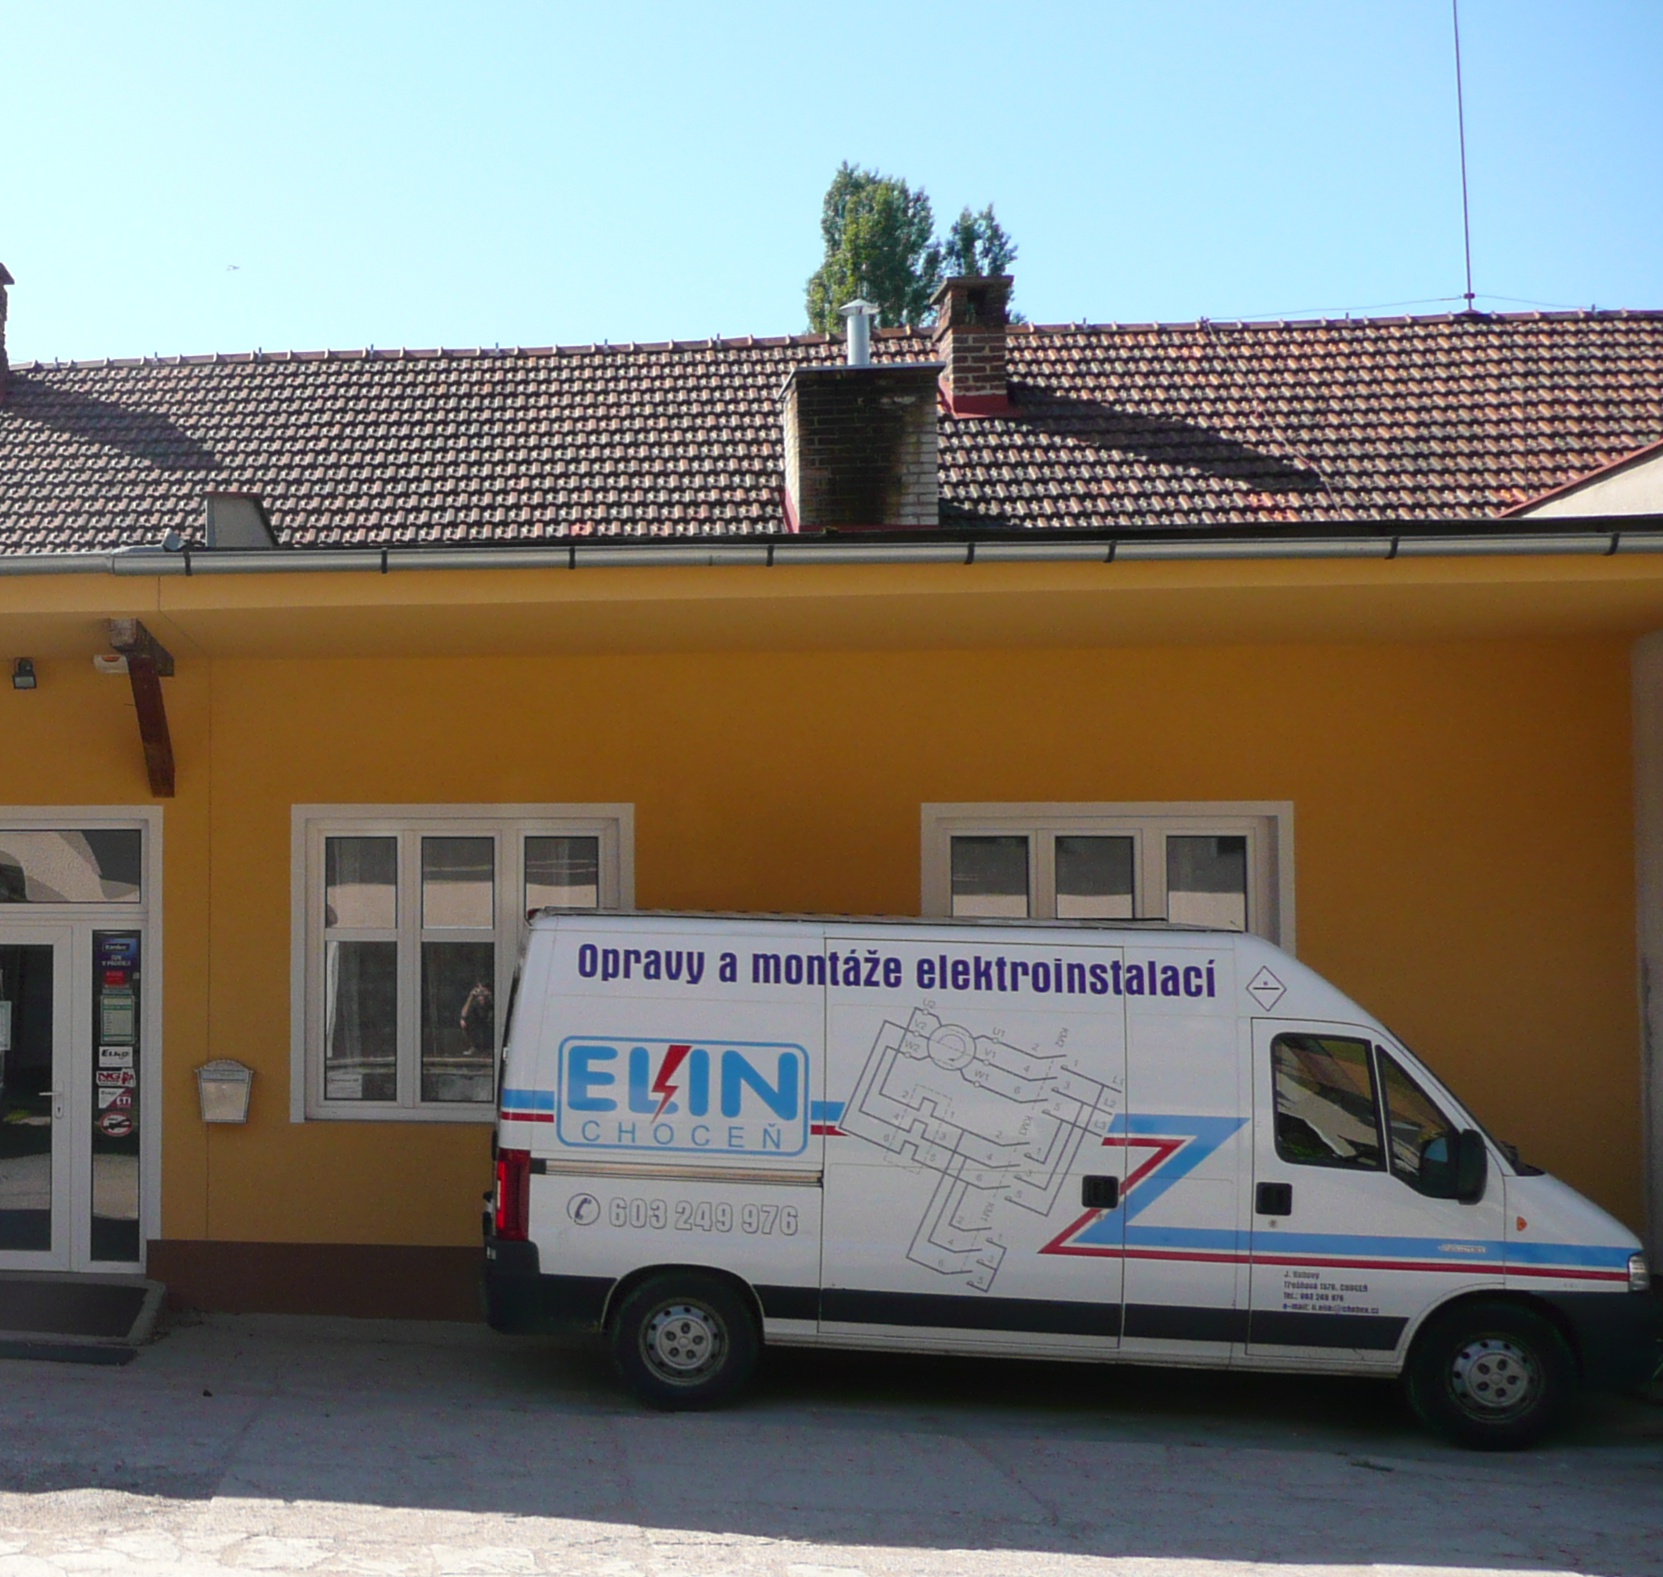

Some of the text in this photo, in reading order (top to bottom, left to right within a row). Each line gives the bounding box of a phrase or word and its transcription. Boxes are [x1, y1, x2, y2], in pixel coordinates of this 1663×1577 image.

[578, 943, 1216, 998] Opravy a montáže elektroinstalací
[992, 1027, 1006, 1038] U1
[985, 1048, 996, 1058] V1
[567, 1045, 799, 1121] ELIN
[974, 1070, 990, 1081] W1
[581, 1119, 782, 1150] CHOCEŇ
[608, 1197, 799, 1236] 603 249 976
